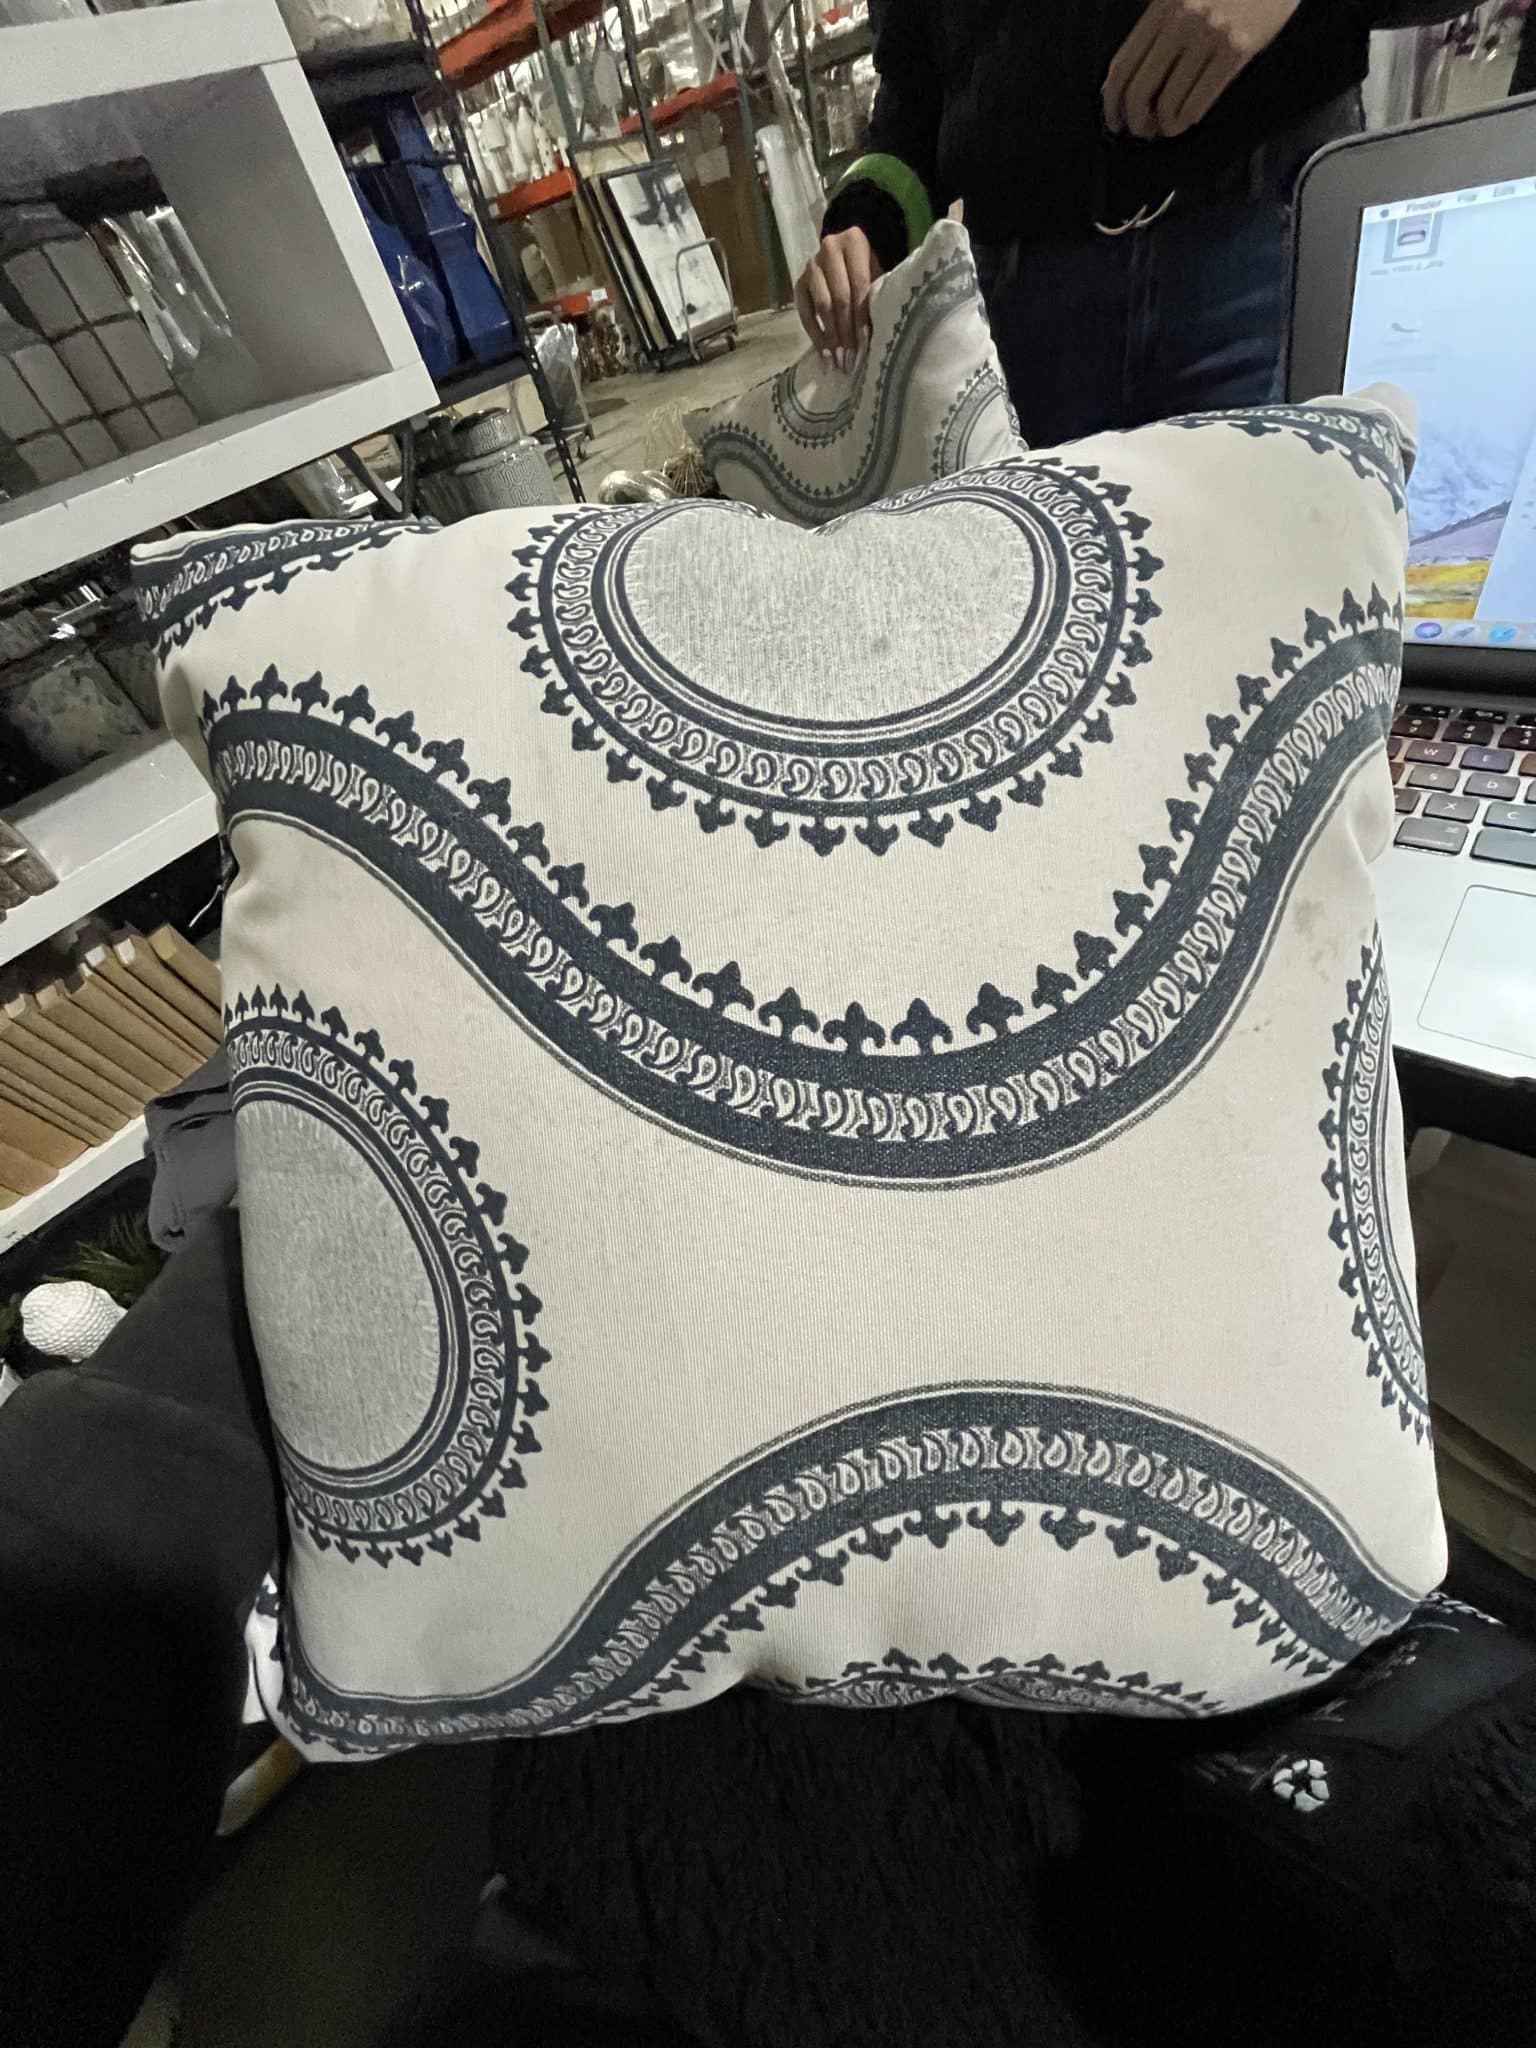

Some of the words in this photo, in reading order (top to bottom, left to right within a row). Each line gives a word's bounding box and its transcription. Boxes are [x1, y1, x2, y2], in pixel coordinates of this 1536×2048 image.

[1424, 748, 1439, 756] W
[1487, 781, 1498, 789] D
[1444, 802, 1457, 811] X
[1507, 811, 1519, 820] C
